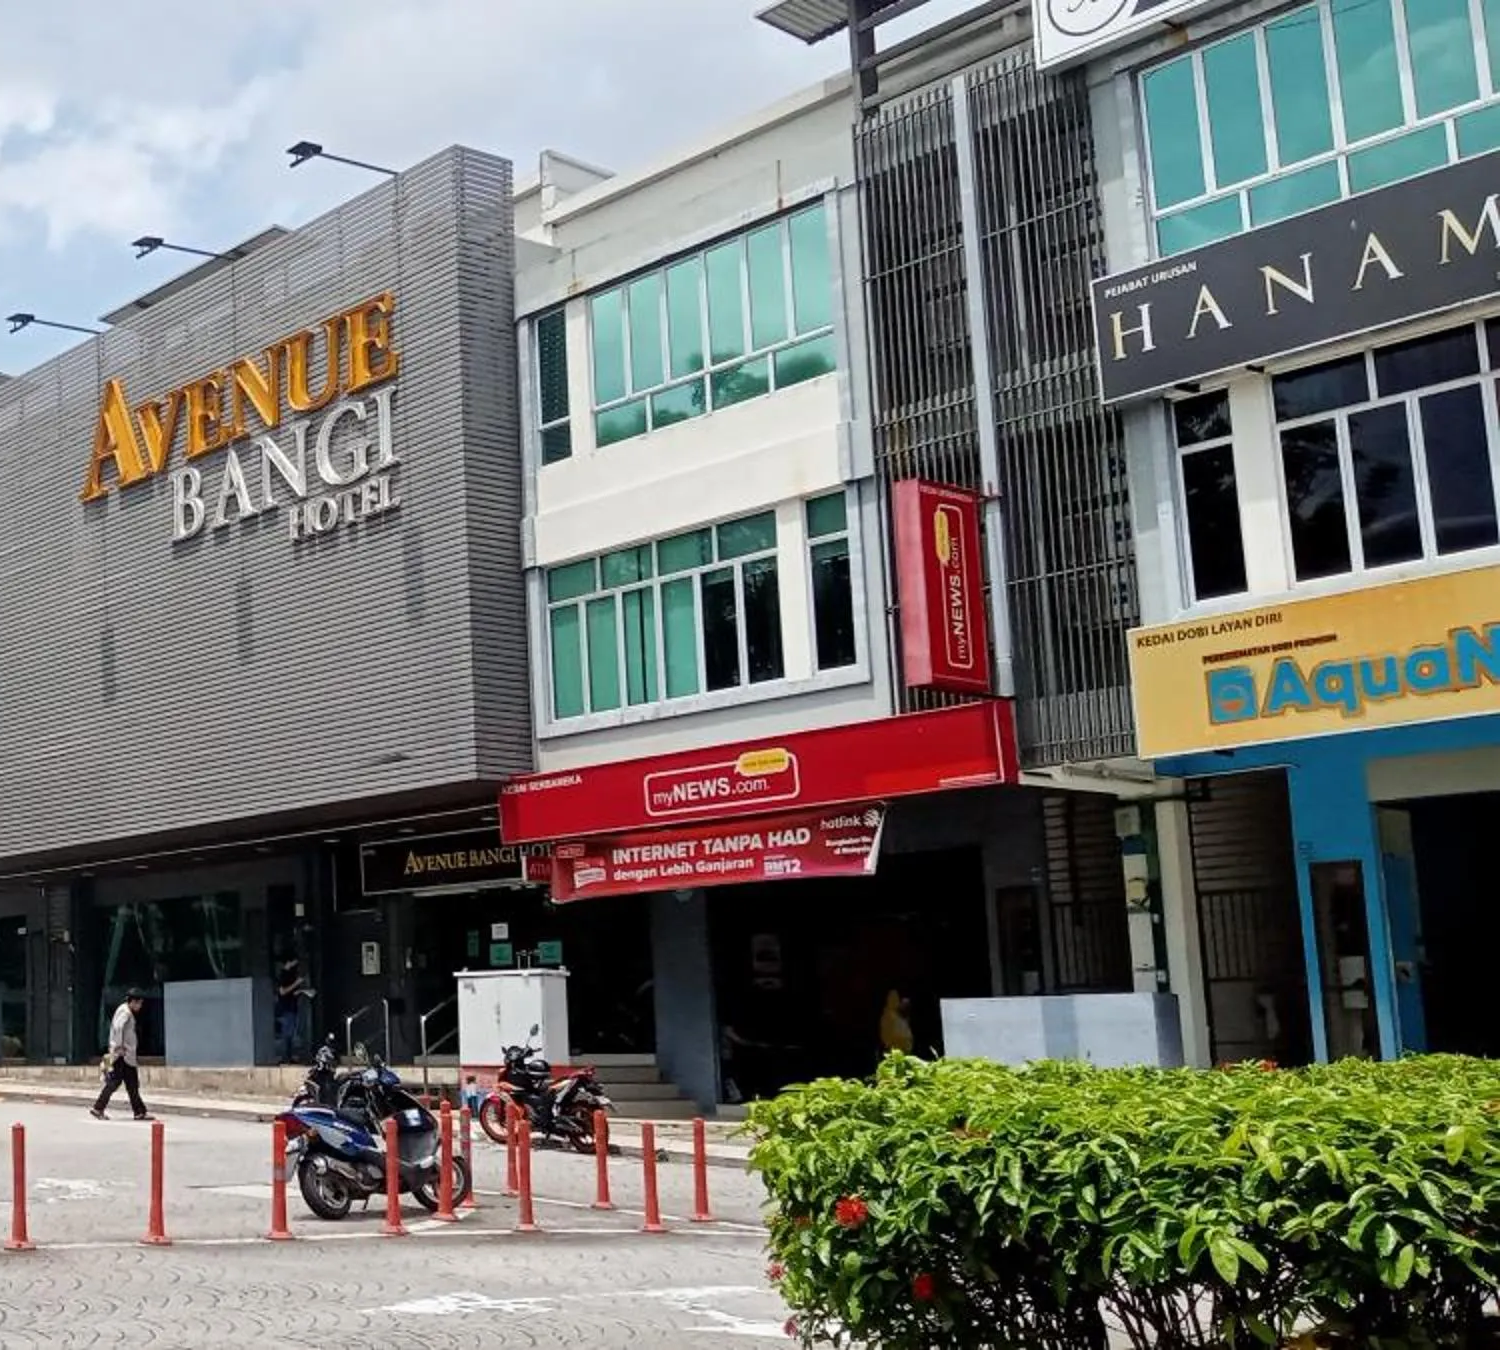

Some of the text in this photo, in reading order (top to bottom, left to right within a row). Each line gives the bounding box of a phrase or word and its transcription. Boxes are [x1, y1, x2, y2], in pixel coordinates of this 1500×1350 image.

[1104, 260, 1197, 299] PEJABAT URUSAN
[1109, 193, 1500, 361] HANAM
[79, 289, 402, 502] AVENUE
[171, 385, 399, 544] BANGI
[288, 474, 400, 543] HOTEL
[949, 536, 968, 660] myNEWS.com
[1137, 611, 1283, 649] KEDAI DOBI LAYAN DIRI
[652, 776, 770, 806] myNEWS.com
[820, 815, 861, 830] hotlink
[404, 850, 467, 875] AVENUE
[469, 846, 516, 867] BANGI
[612, 840, 698, 865] INTERNET
[702, 833, 764, 856] TANPA
[767, 827, 811, 848] HAD
[613, 867, 657, 882] dengan
[660, 860, 693, 877] Lebih
[695, 857, 755, 877] Ganjaran
